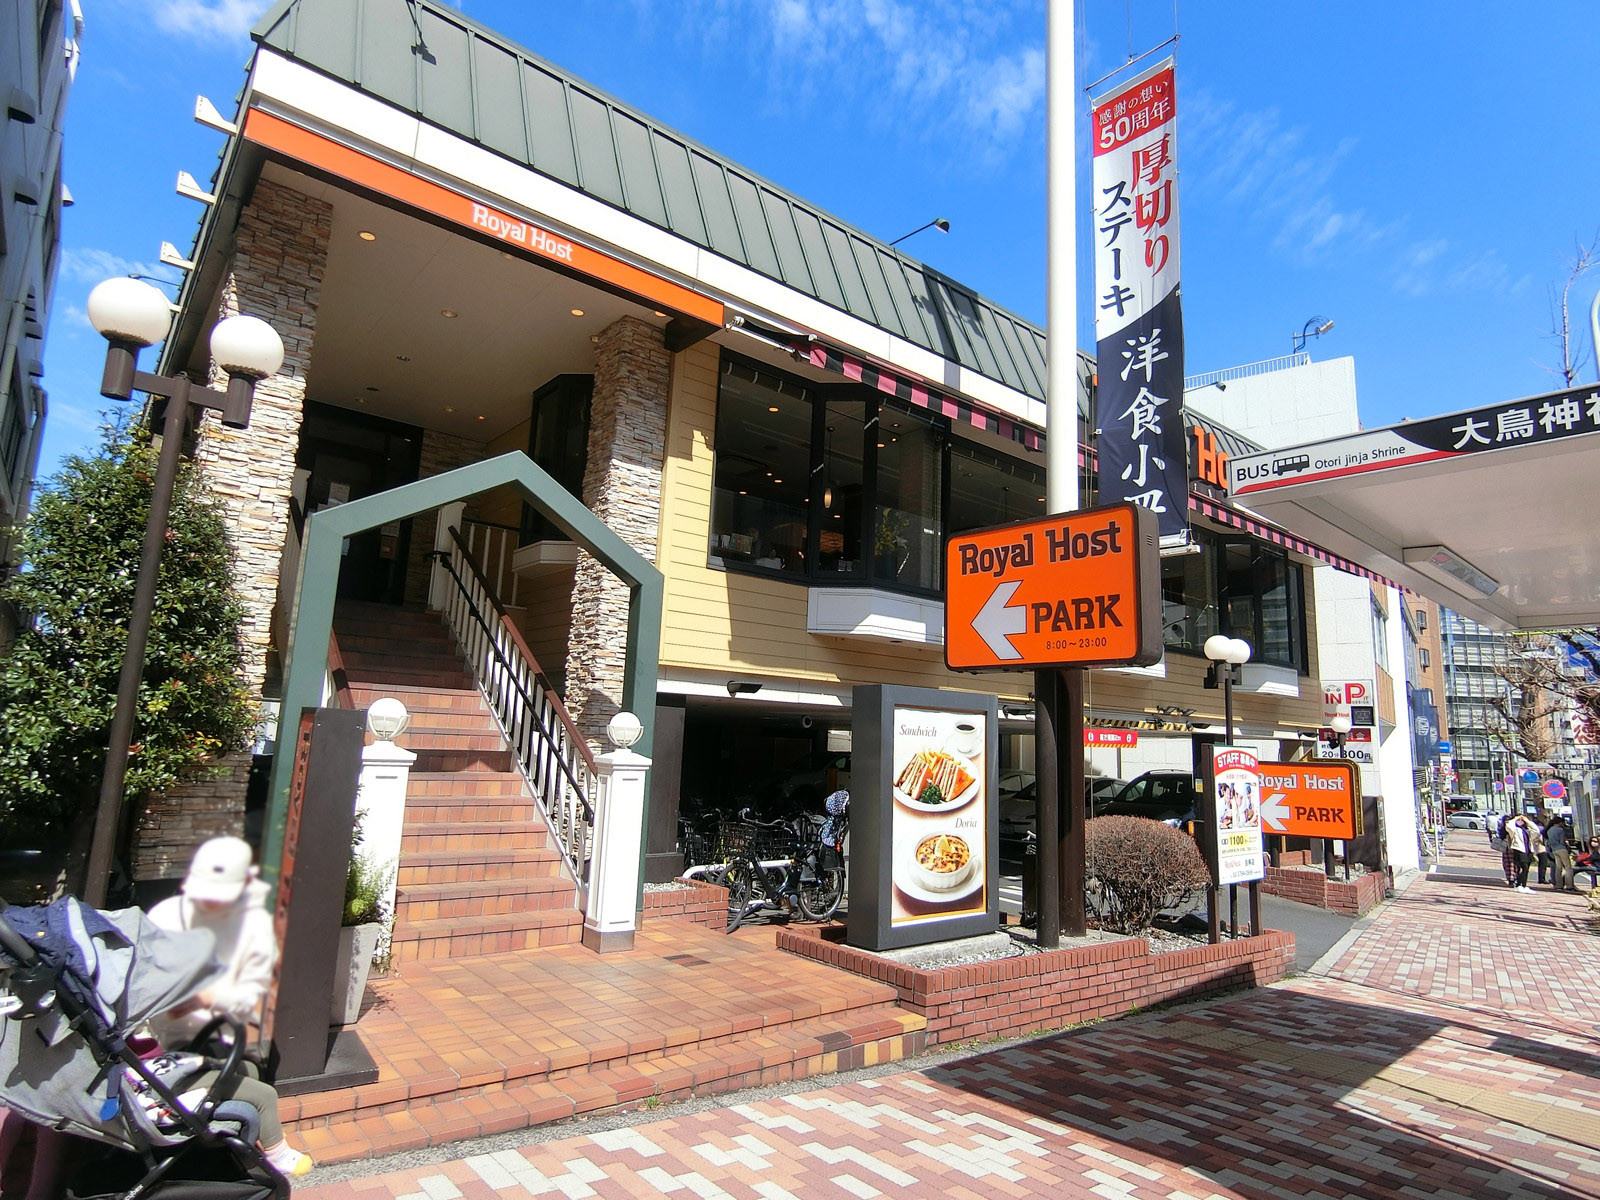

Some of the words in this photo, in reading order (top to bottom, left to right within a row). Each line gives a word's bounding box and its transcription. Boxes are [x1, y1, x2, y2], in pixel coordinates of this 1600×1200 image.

[1099, 81, 1168, 126] 感謝の想い
[1100, 97, 1171, 149] 50周年
[1131, 132, 1172, 278] 厚切り
[471, 202, 527, 242] Royal
[530, 226, 573, 262] Host
[1099, 181, 1135, 317] ステーキ
[1236, 463, 1270, 482] BUS
[1314, 456, 1341, 470] Otori
[1345, 453, 1369, 467] jinja
[1372, 445, 1406, 460] Shrine
[958, 532, 1034, 578] Royal
[1045, 521, 1122, 563] Host
[1031, 594, 1123, 634] PARK
[1324, 693, 1342, 704] IN
[899, 724, 937, 738] Sandwich
[1258, 772, 1298, 791] Royal
[1303, 774, 1345, 791] Host
[955, 817, 978, 829] Doria
[1294, 806, 1346, 824] PARK
